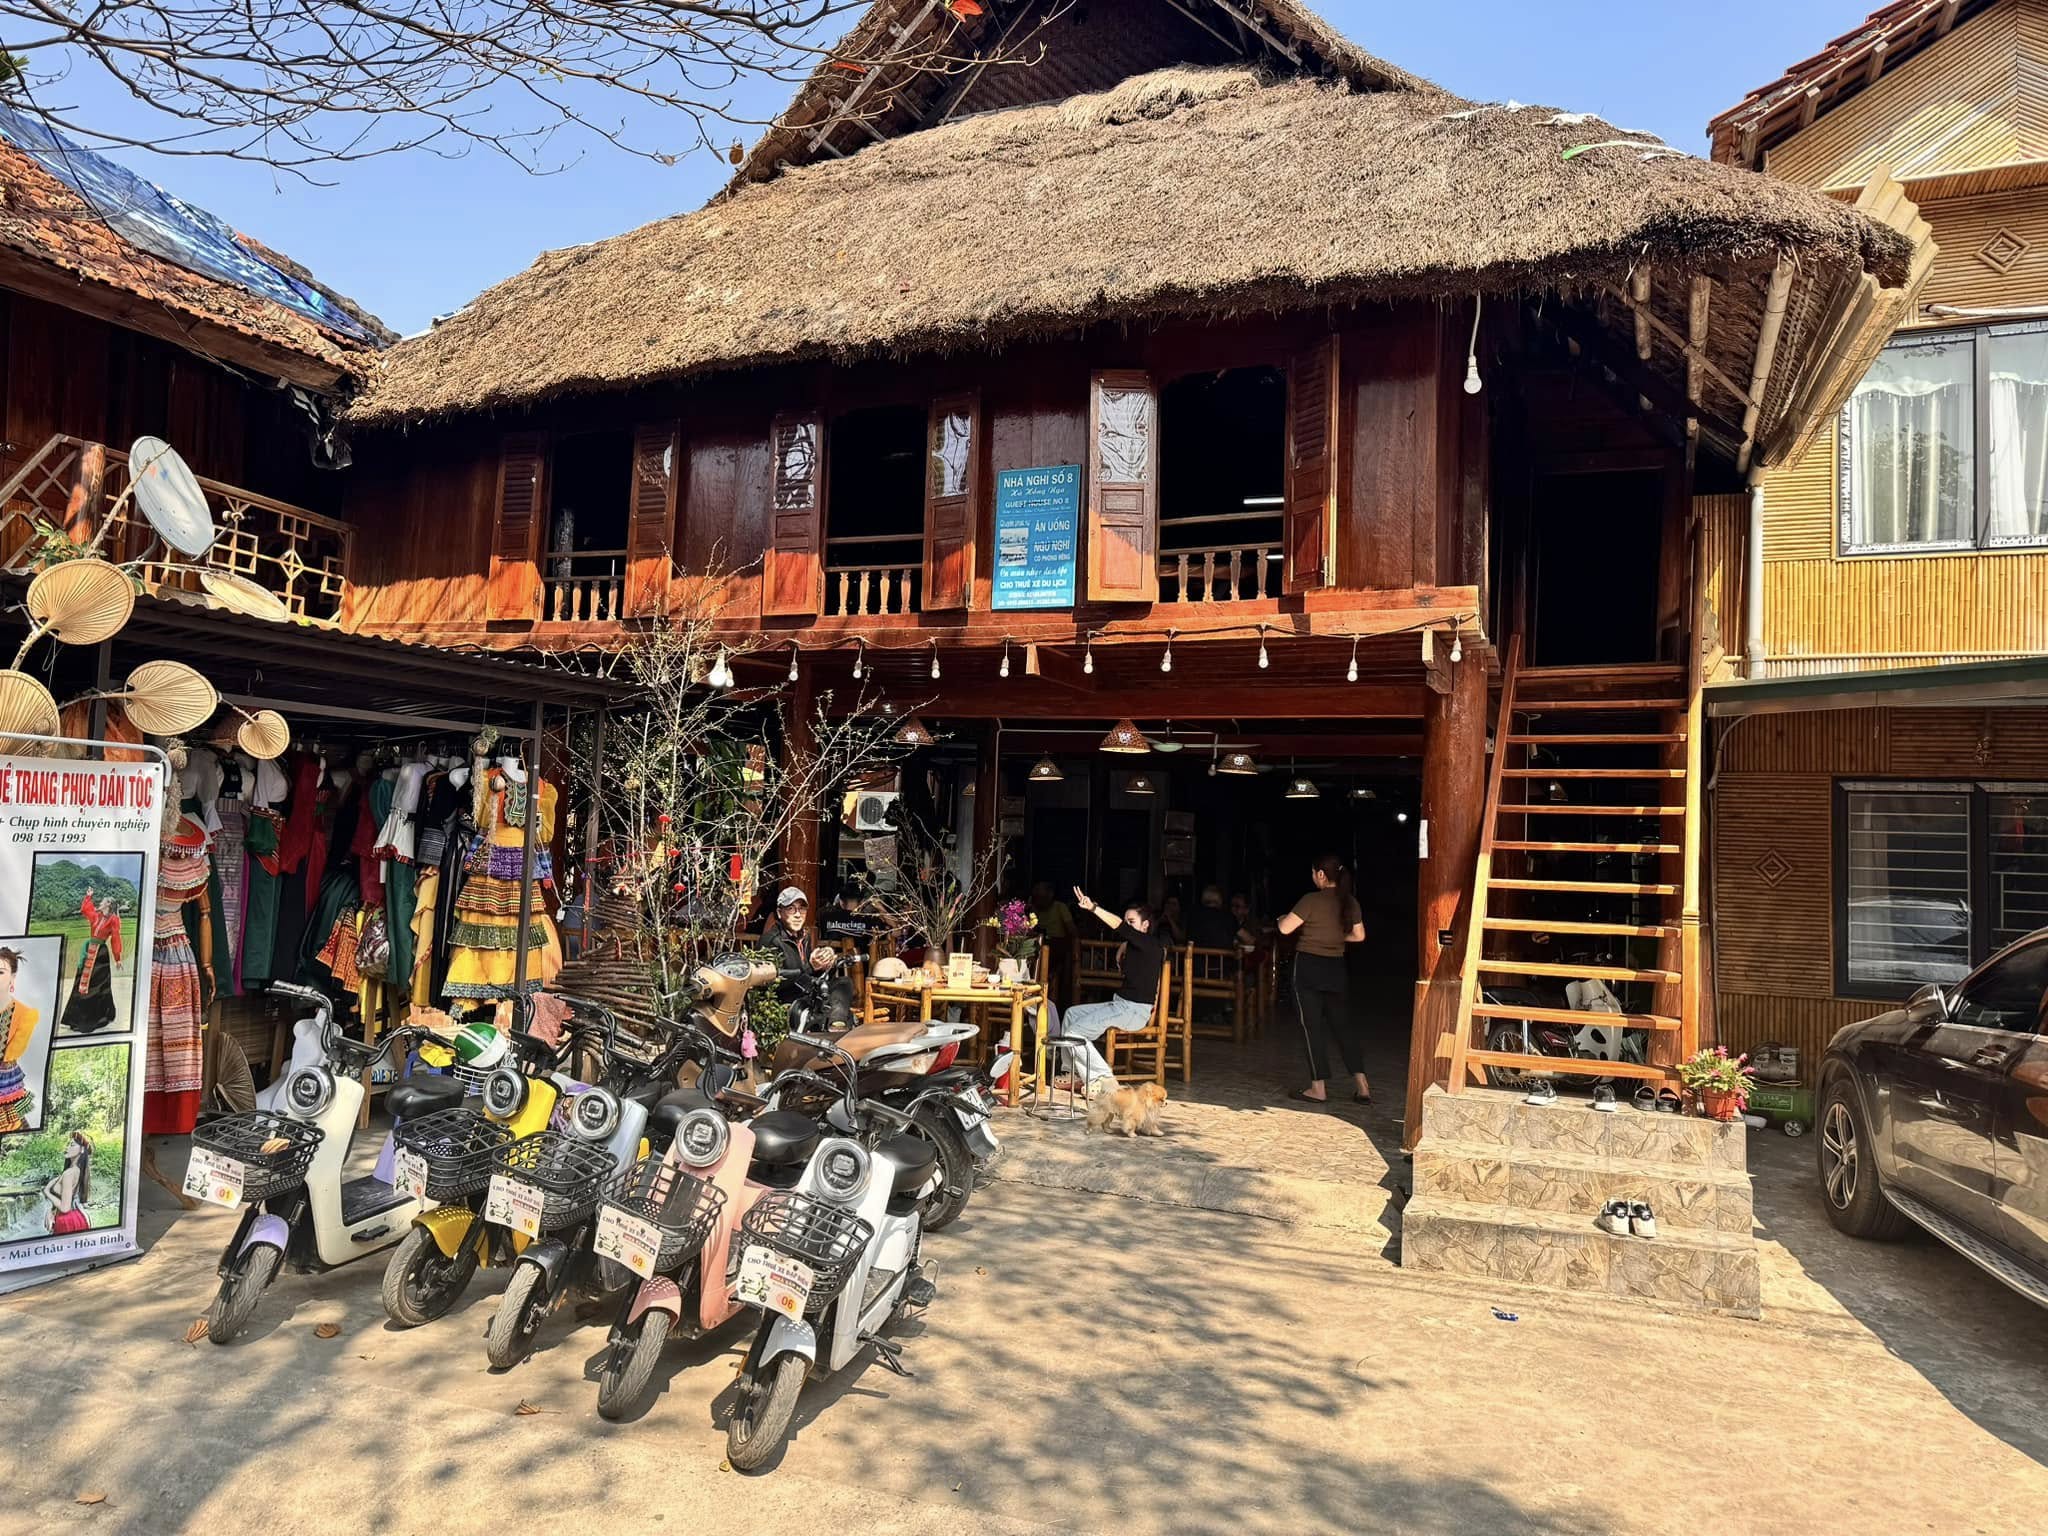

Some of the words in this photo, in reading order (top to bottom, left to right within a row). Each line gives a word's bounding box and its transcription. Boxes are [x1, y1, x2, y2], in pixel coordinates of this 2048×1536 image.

[1026, 471, 1049, 486] NGHỈ
[1052, 469, 1065, 484] SỐ
[1067, 472, 1073, 483] 8
[1048, 516, 1070, 531] UỐNG
[15, 769, 58, 806] TRANG
[61, 772, 95, 814] PHỤC
[99, 767, 125, 807] DÂN
[128, 769, 153, 815] TỘC
[9, 815, 40, 831] Chụp
[43, 816, 68, 828] hình
[71, 818, 111, 832] chuyên
[114, 818, 150, 833] nghiệp
[11, 832, 34, 843] 098
[37, 832, 57, 843] 152
[60, 832, 87, 843] 1993
[218, 1188, 230, 1200] 01
[524, 1219, 533, 1229] 10
[9, 1248, 31, 1260] Mai
[34, 1244, 63, 1255] Châu
[74, 1238, 96, 1249] Hòa
[100, 1233, 124, 1245] Bình
[633, 1255, 643, 1266] 09
[782, 1296, 792, 1309] 06
